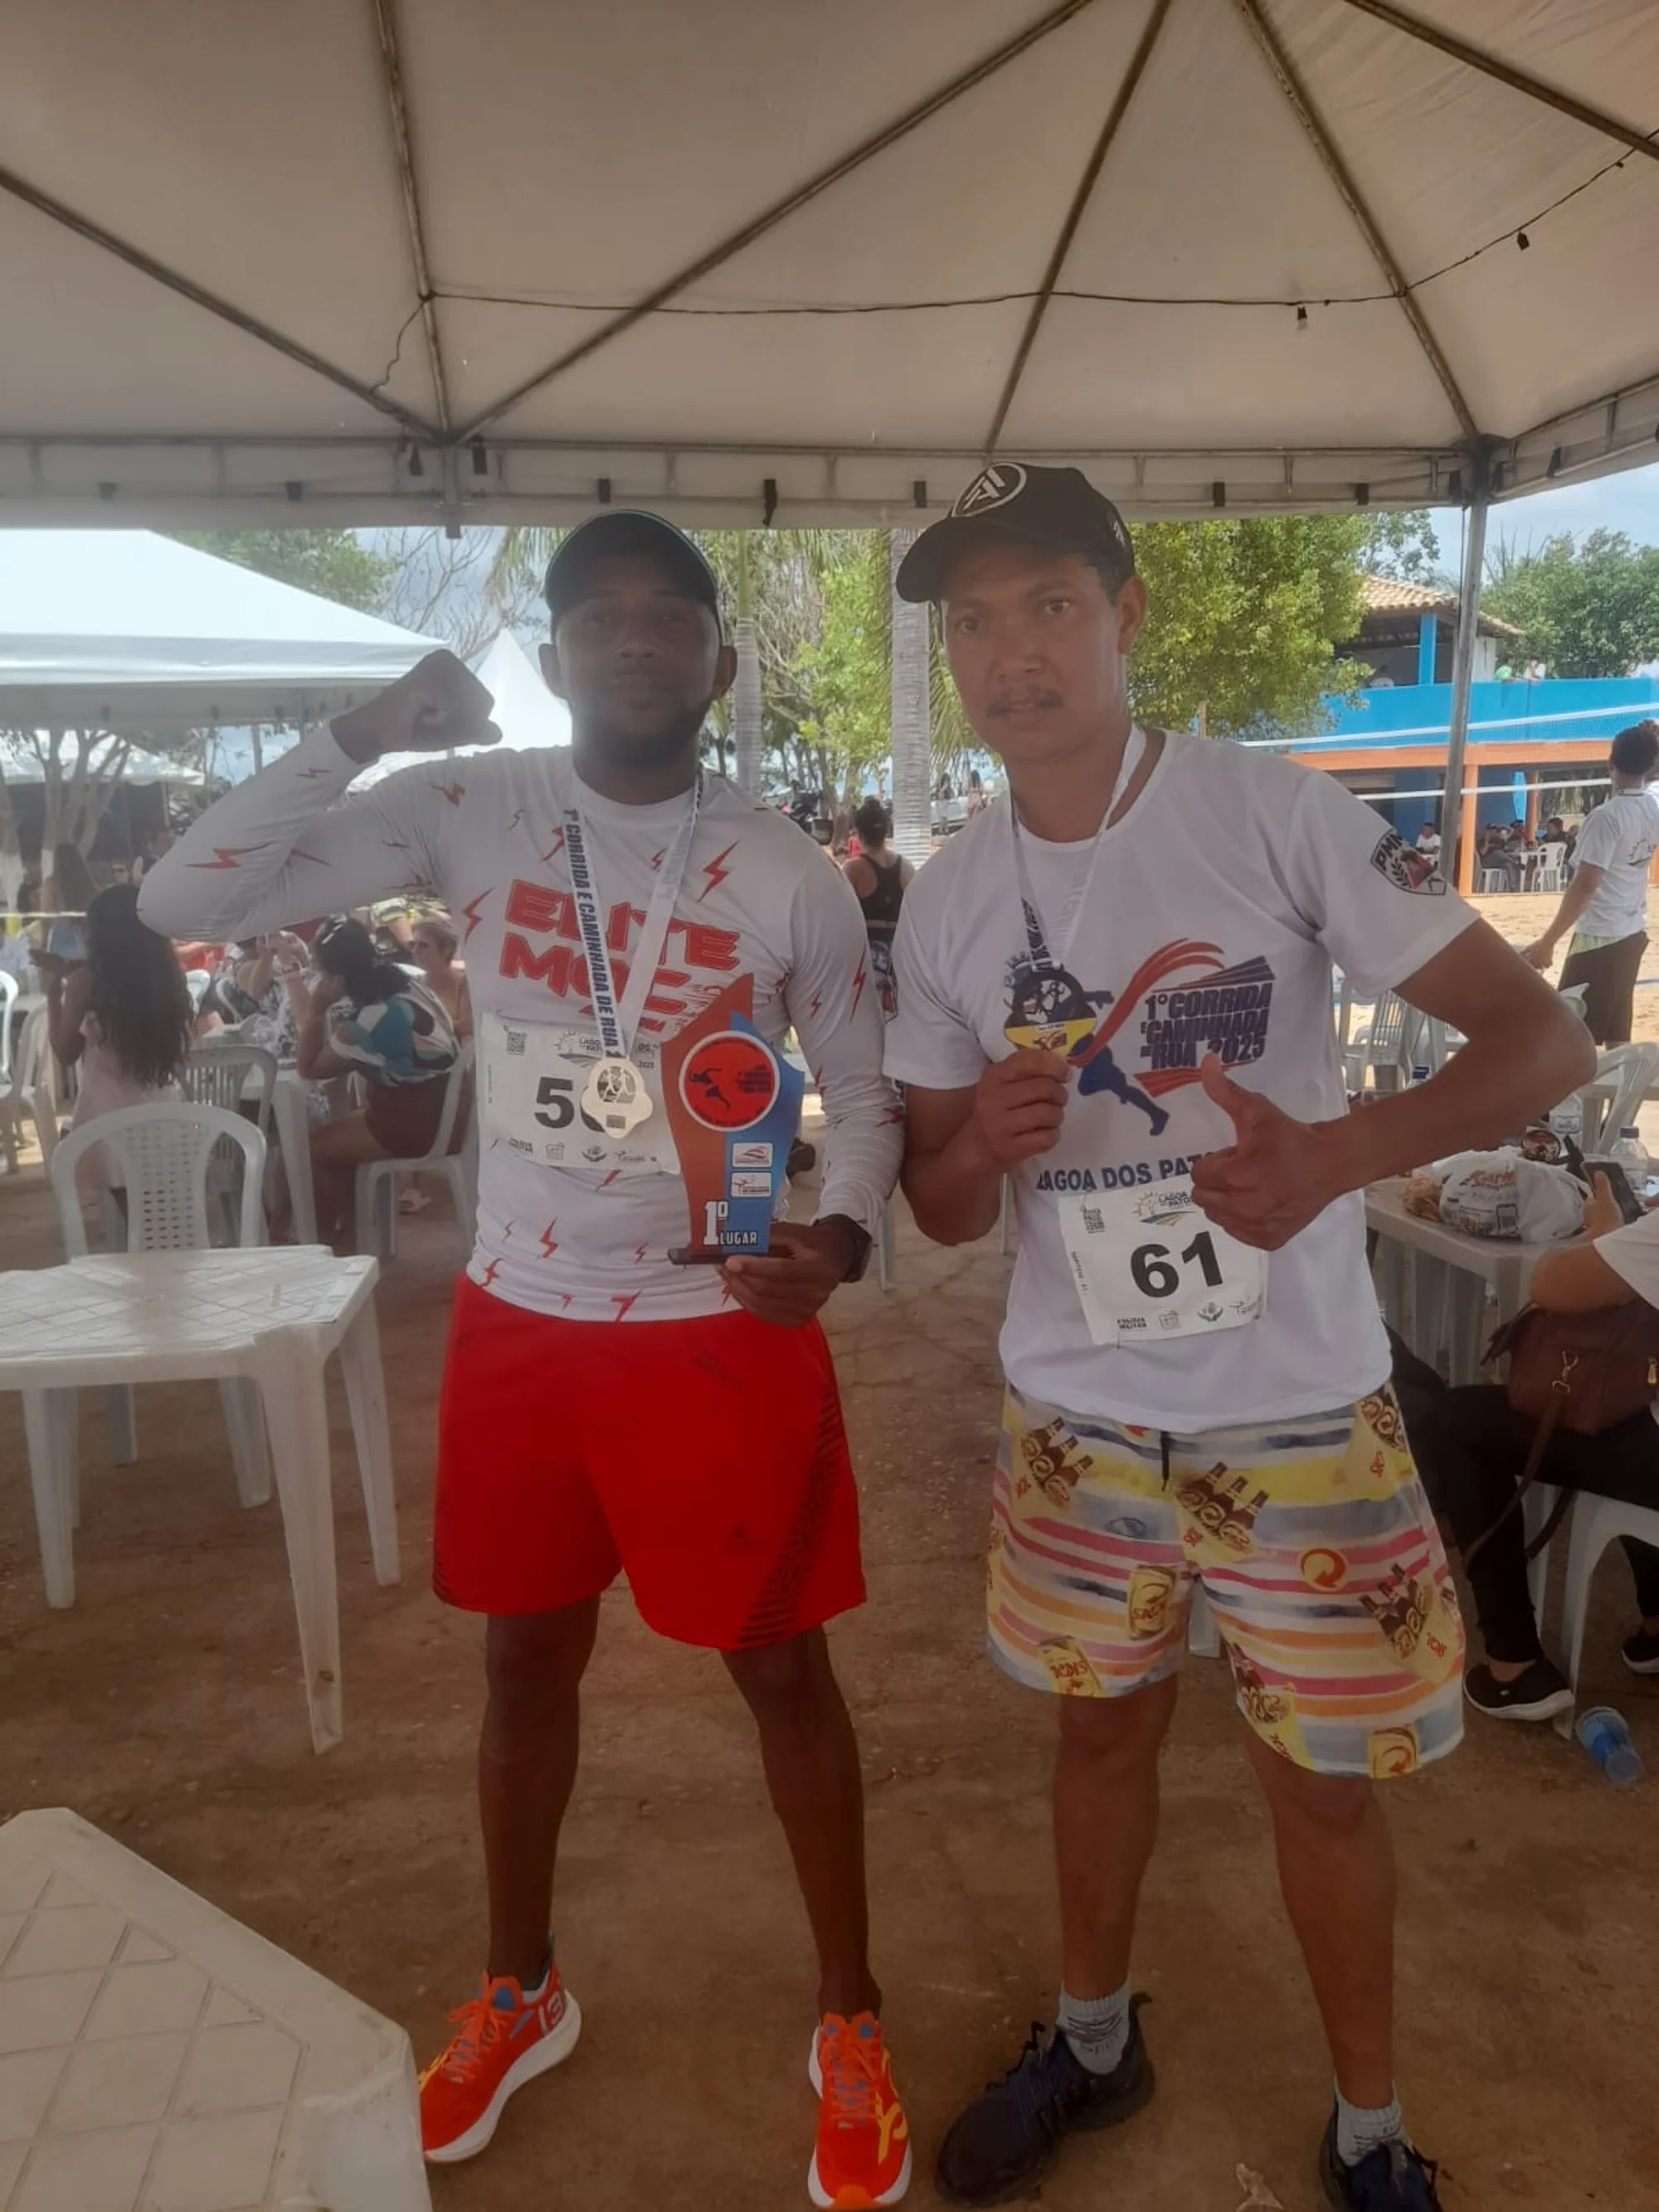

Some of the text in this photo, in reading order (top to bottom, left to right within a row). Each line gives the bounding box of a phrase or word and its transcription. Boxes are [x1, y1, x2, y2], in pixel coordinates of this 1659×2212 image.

[565, 824, 591, 889] CORRIDA
[577, 891, 593, 902] E
[578, 902, 611, 992] CAMINHADA
[596, 994, 615, 1015] DE
[1169, 982, 1273, 1019] CORRIDA
[600, 1016, 620, 1046] RUA
[1146, 1009, 1270, 1044] CAMINHADA
[1151, 1040, 1197, 1070] RUA
[534, 1076, 605, 1133] 5
[1102, 1162, 1153, 1189] DOS
[719, 1232, 758, 1245] LUGAR
[1131, 1231, 1224, 1298] 61
